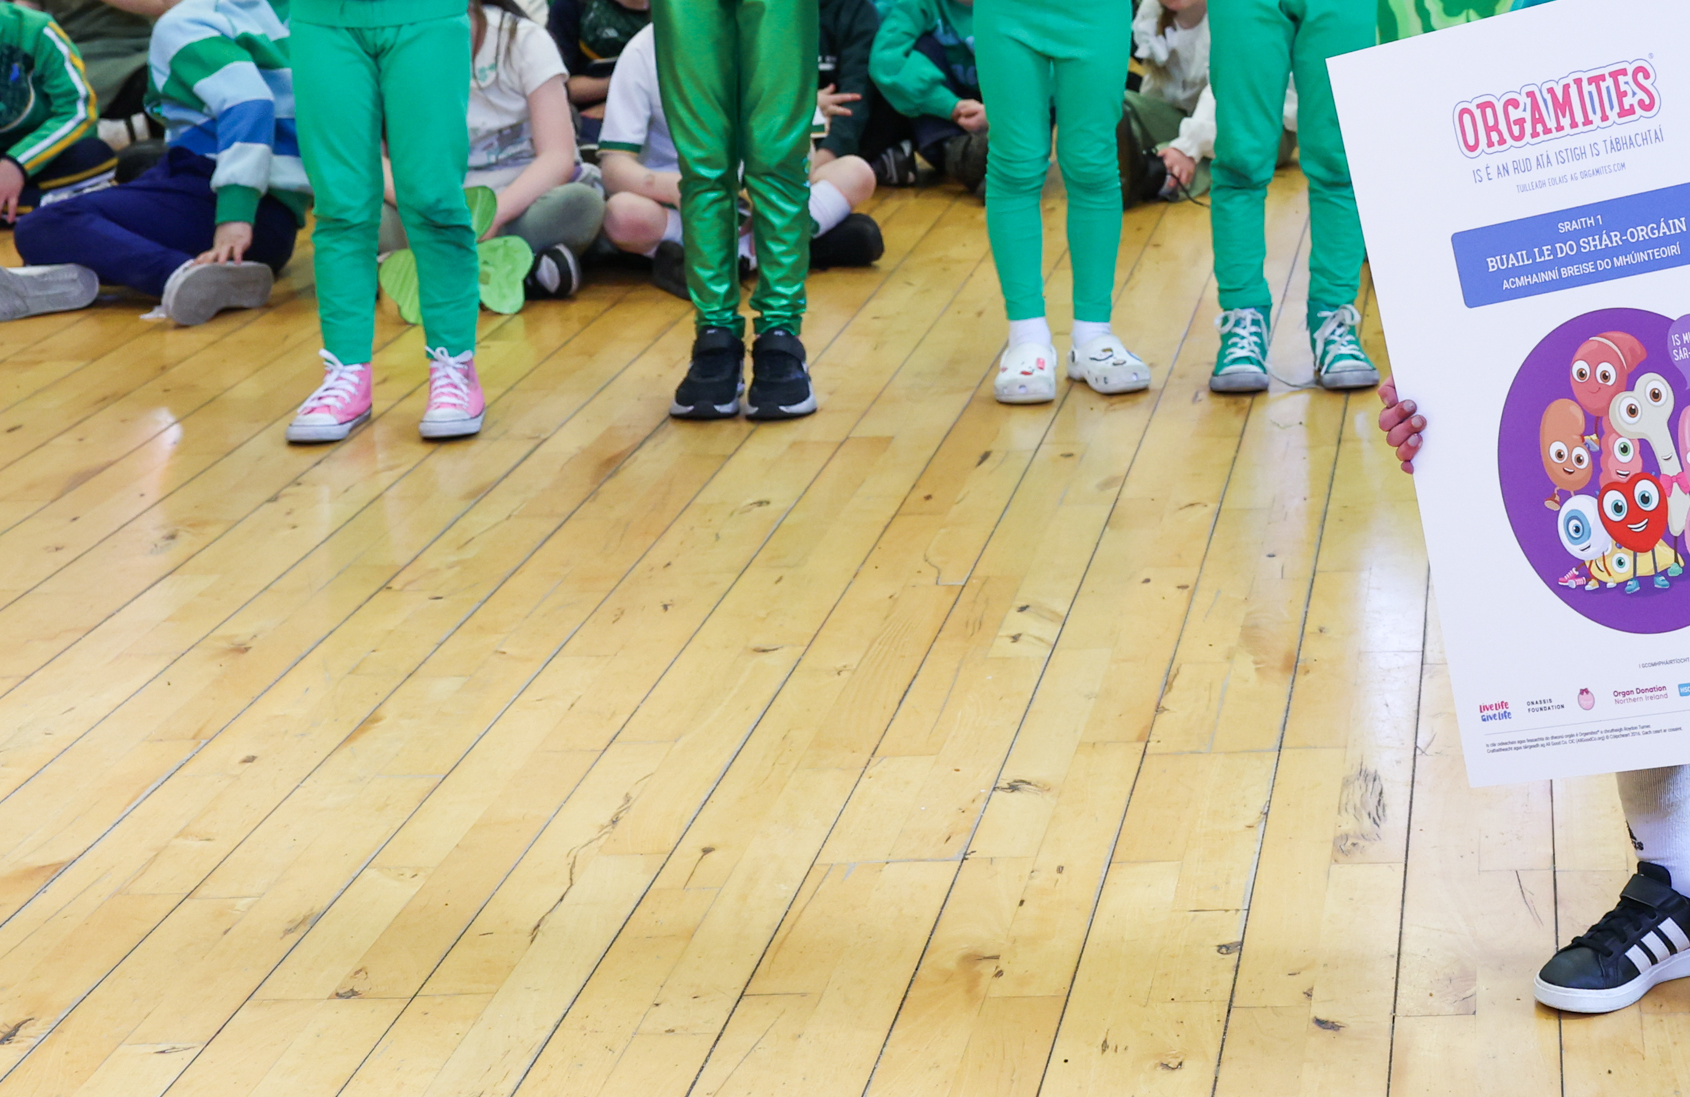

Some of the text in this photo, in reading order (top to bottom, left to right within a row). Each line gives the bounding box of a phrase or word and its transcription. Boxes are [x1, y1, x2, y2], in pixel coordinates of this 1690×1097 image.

[1458, 65, 1656, 153] ORGAMITES
[1472, 124, 1663, 183] IS É AN RUD ATÁ ISTIGH IS TÁBHACHTAÍ
[1570, 172, 1578, 181] AG
[1557, 214, 1602, 233] SRAITH 1
[1486, 216, 1686, 272] BUAIL LE DO SHÁR-ORGÁIN
[1502, 241, 1680, 290] ACMHAINNÍ BREISE DO MHÚINTEOIRÍ
[1671, 333, 1680, 346] IS
[1612, 684, 1667, 699] Organ Donation
[1679, 686, 1690, 694] HSC
[1526, 698, 1552, 706] ONASSIS
[1614, 692, 1668, 704] Northern Ireland
[1527, 704, 1564, 712] FOUNDATION
